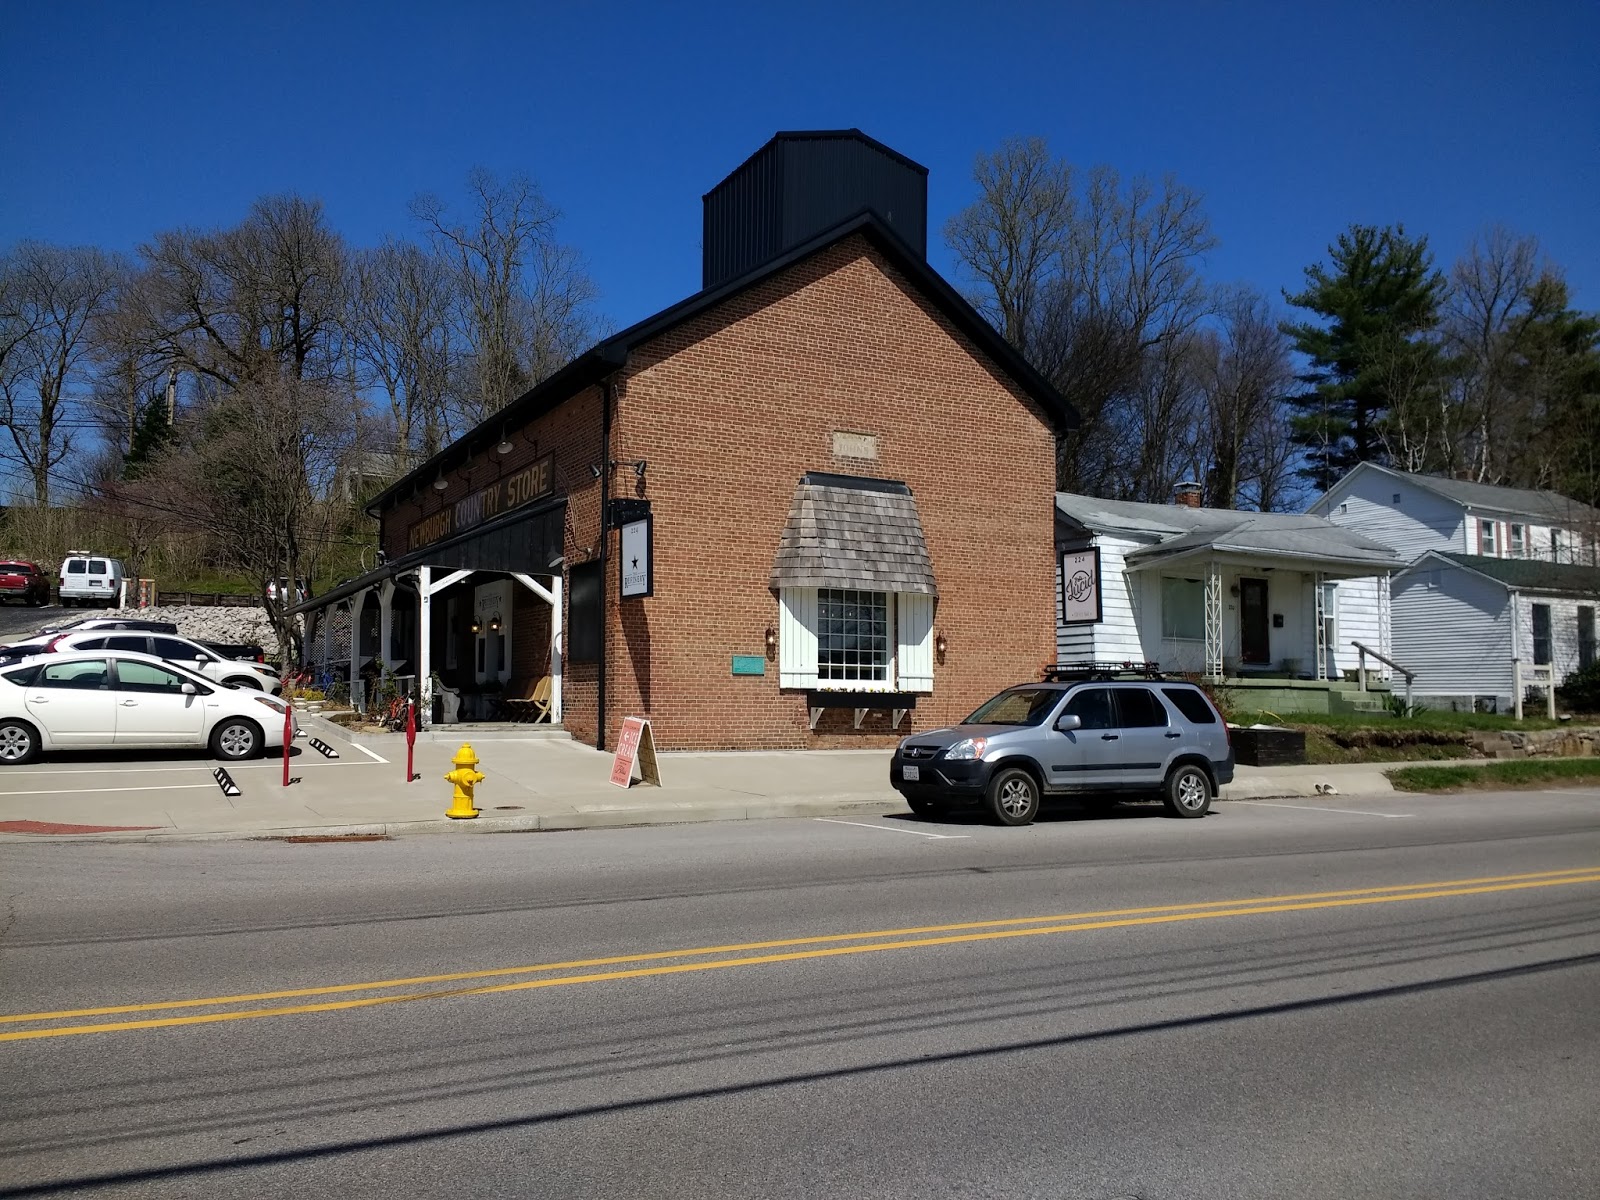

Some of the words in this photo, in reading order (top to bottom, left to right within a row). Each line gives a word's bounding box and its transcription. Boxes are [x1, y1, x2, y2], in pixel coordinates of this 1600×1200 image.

[409, 509, 451, 550] NEWBURGH
[454, 484, 501, 529] COUNTRY
[507, 461, 549, 507] STORE
[1066, 569, 1096, 601] Lucid
